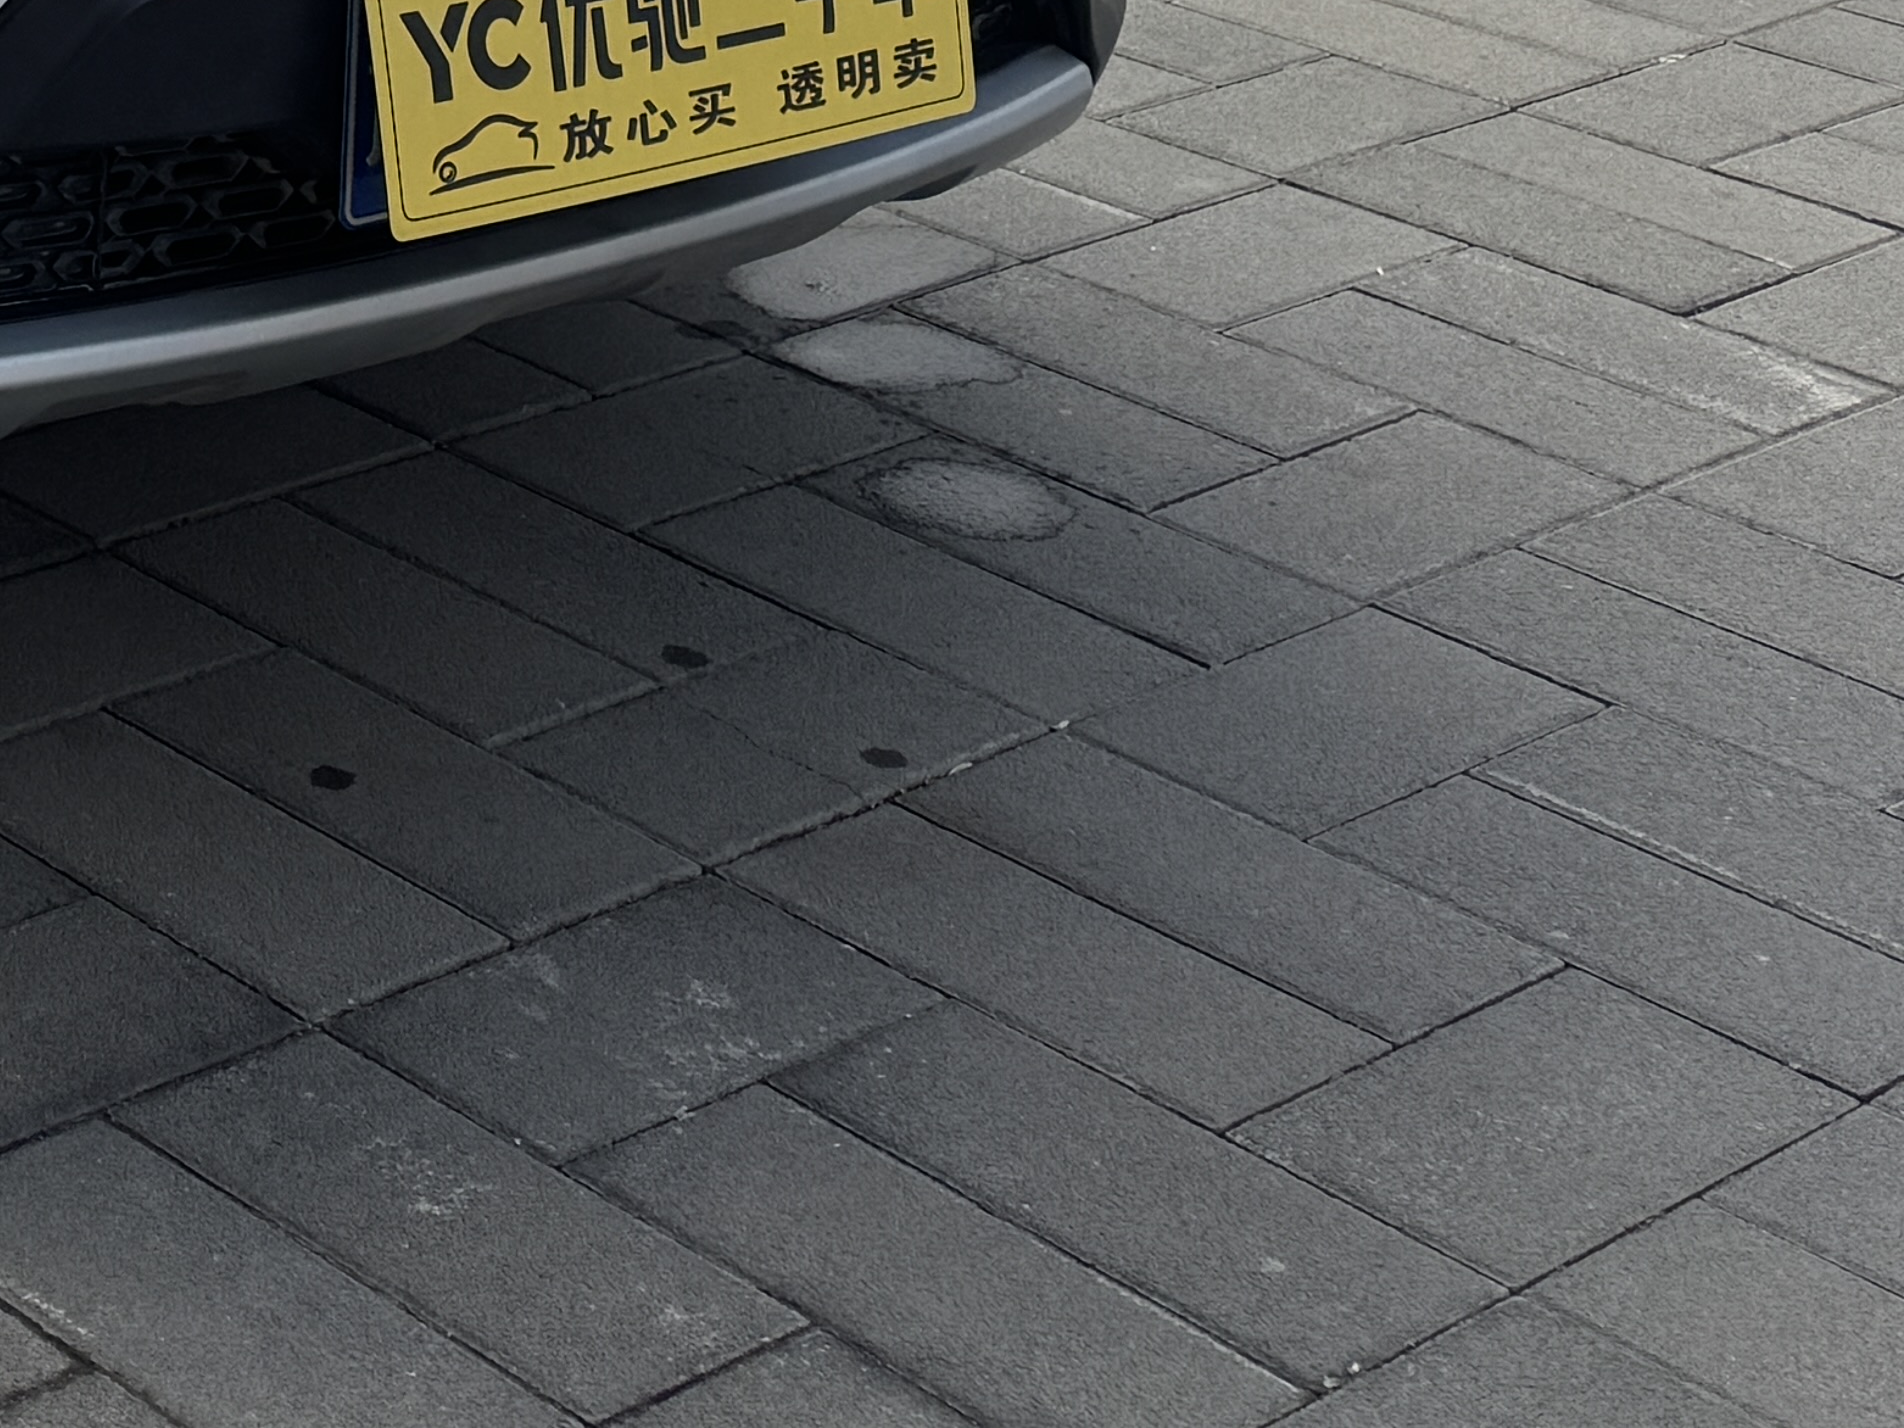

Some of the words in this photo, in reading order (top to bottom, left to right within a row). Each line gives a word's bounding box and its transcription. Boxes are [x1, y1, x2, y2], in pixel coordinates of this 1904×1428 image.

[559, 82, 737, 163] 放心买
[776, 38, 938, 115] 透明卖
